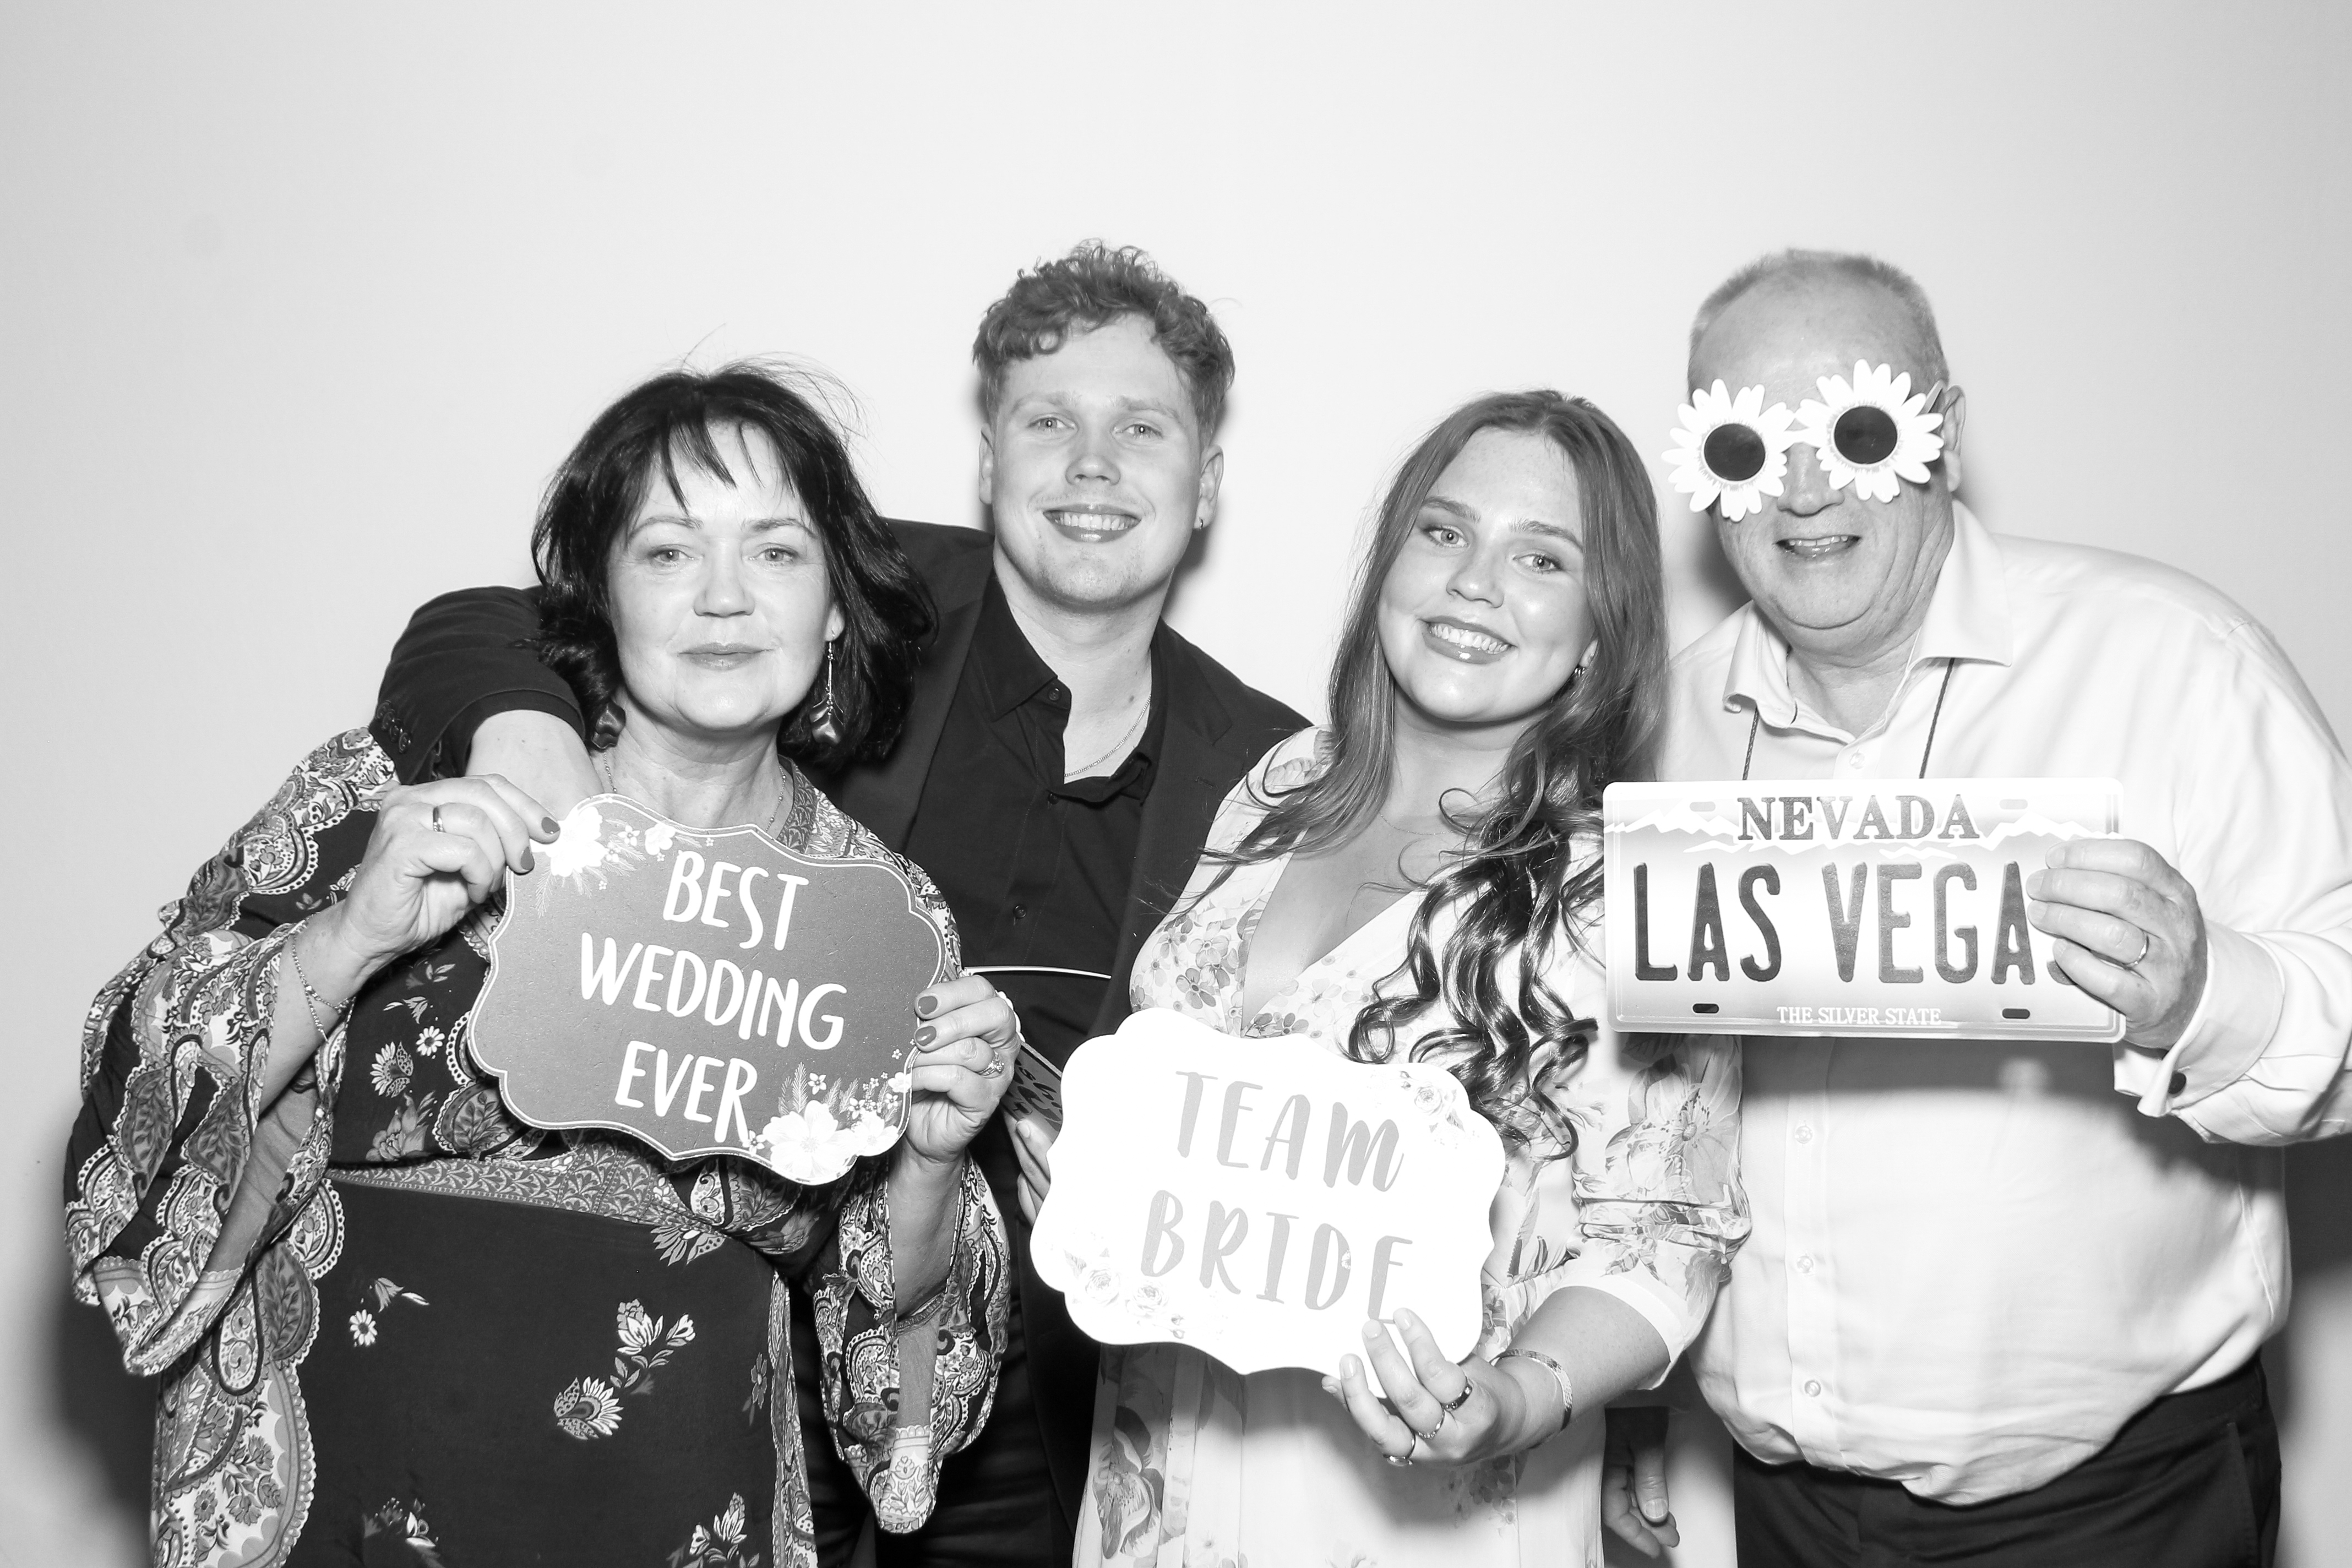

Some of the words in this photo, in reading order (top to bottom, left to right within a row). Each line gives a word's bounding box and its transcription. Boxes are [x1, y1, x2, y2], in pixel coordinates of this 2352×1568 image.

[1737, 794, 1980, 840] NEVADA
[663, 850, 809, 951] BEST
[1633, 861, 1782, 982] LAS
[1821, 861, 2077, 986] VEGA
[581, 932, 847, 1050] WEDDING
[1776, 1006, 1814, 1024] THE
[1817, 1006, 1880, 1025] SILVER
[1885, 1008, 1942, 1025] STATE
[614, 1041, 758, 1143] EVER
[1176, 1071, 1404, 1192] TEAM
[1140, 1189, 1413, 1324] BRIDE
